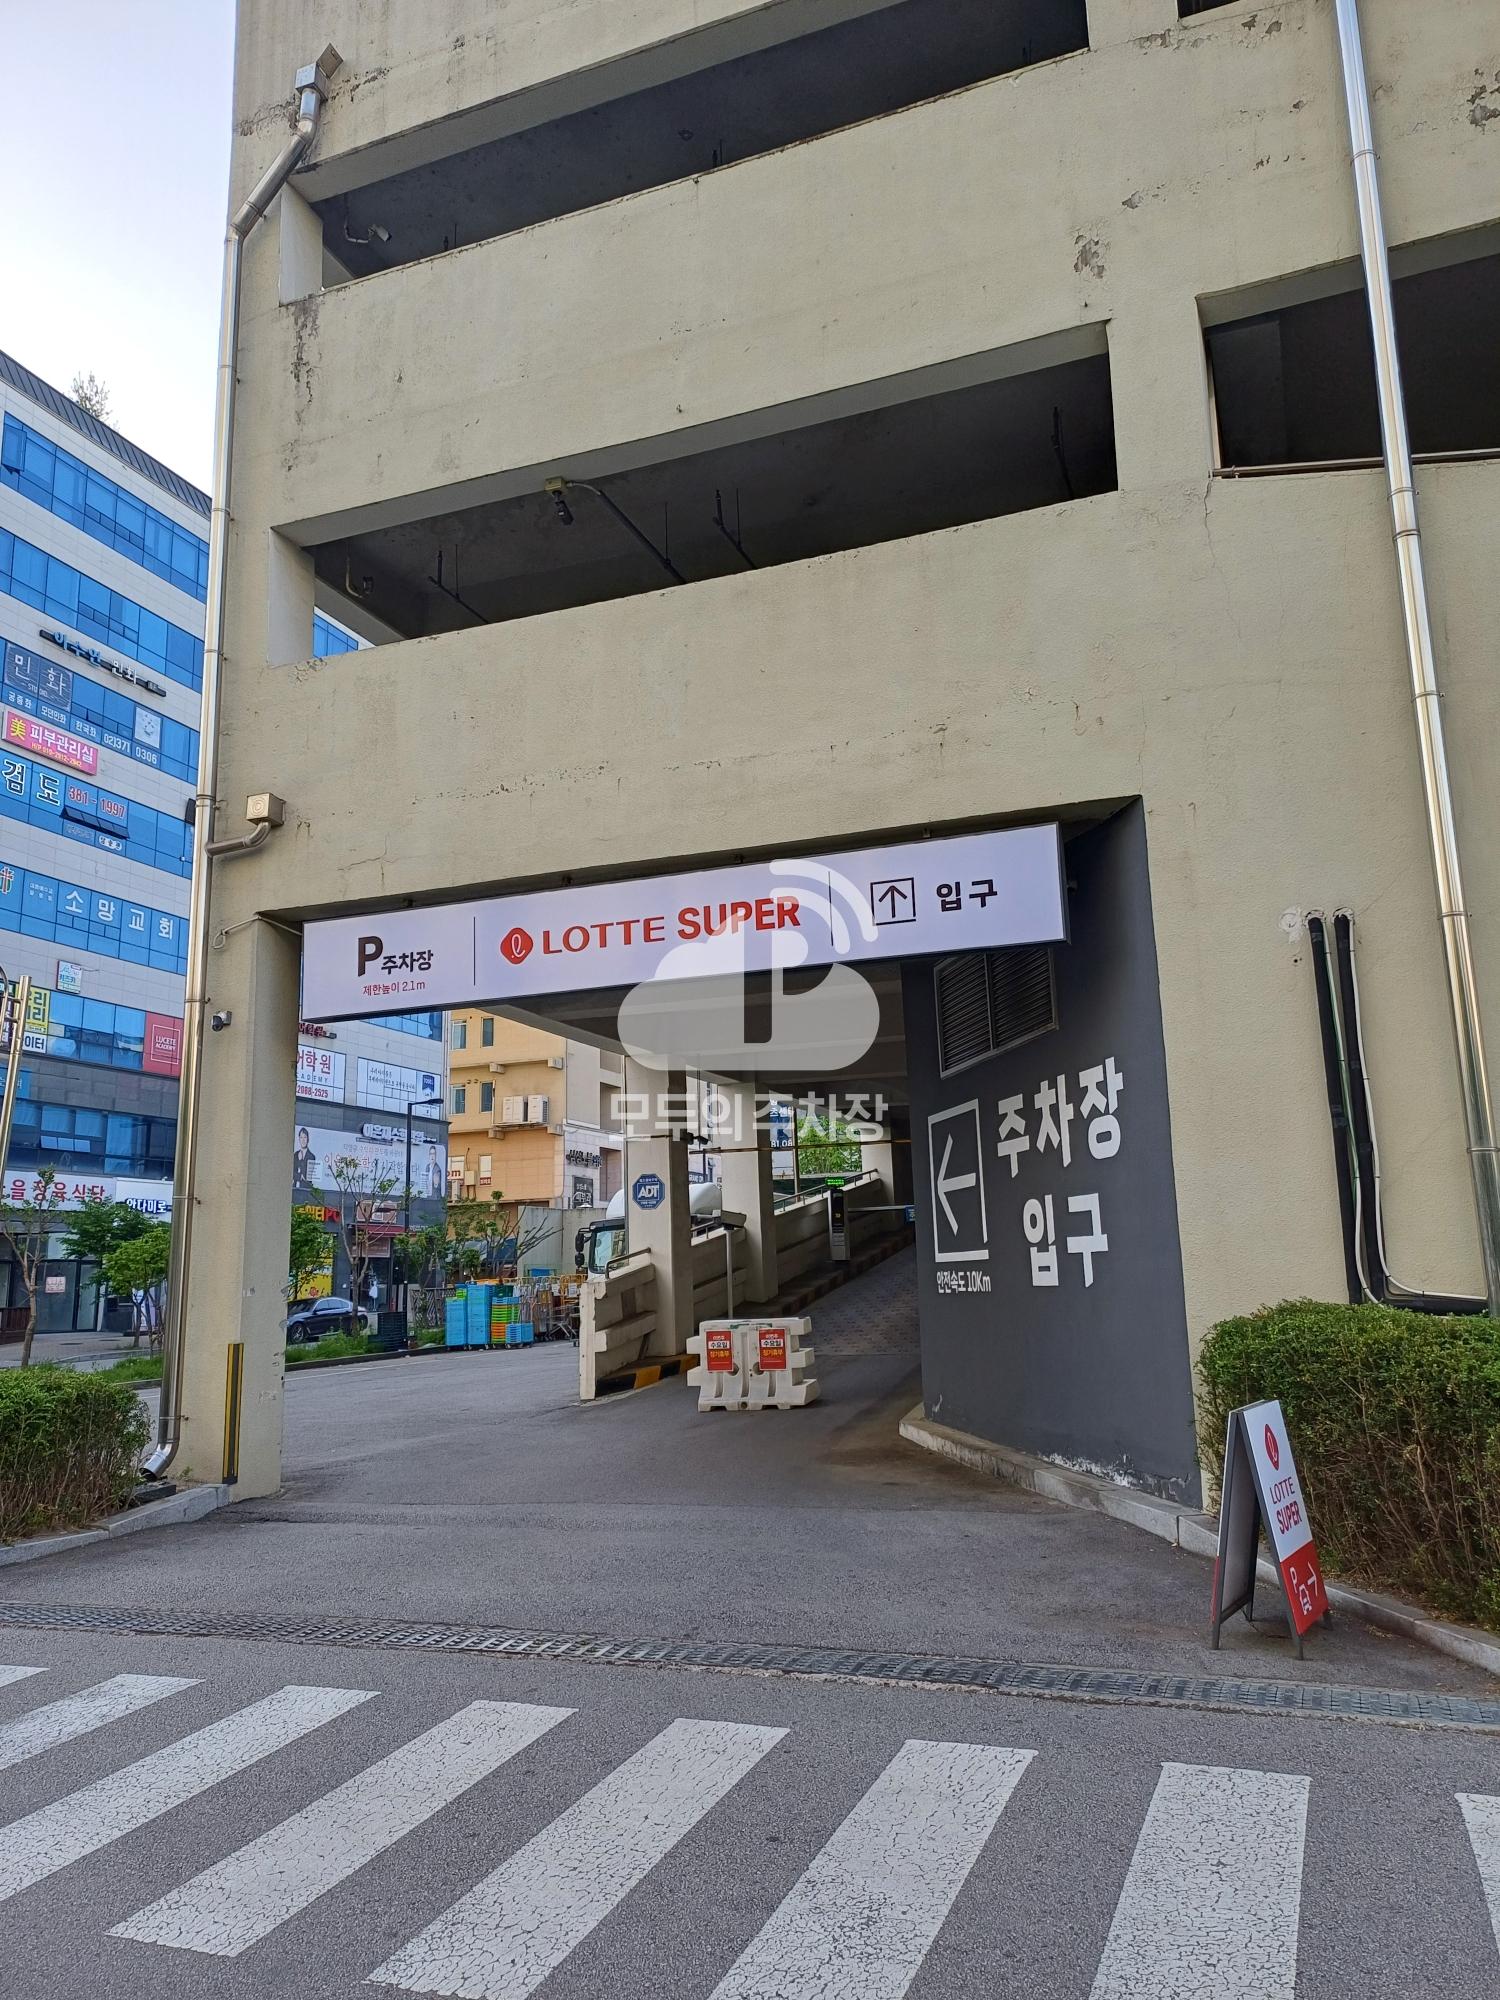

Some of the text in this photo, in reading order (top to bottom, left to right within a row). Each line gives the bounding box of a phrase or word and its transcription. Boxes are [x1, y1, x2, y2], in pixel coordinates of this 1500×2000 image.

[10, 717, 94, 764] 美 피부관리실
[935, 878, 998, 912] 입구
[65, 890, 174, 940] 소망교회
[542, 895, 801, 955] LOTTE SUPER
[381, 949, 434, 975] 주차장
[362, 979, 426, 996] 제한높이 2.1m
[997, 1056, 1124, 1179] 주차장
[638, 1185, 659, 1199] ADT
[1023, 1193, 1109, 1288] 입구
[936, 1271, 992, 1294] 안전속도 10Km
[1269, 1476, 1296, 1505] LOTTE
[1276, 1500, 1303, 1535] SUPER
